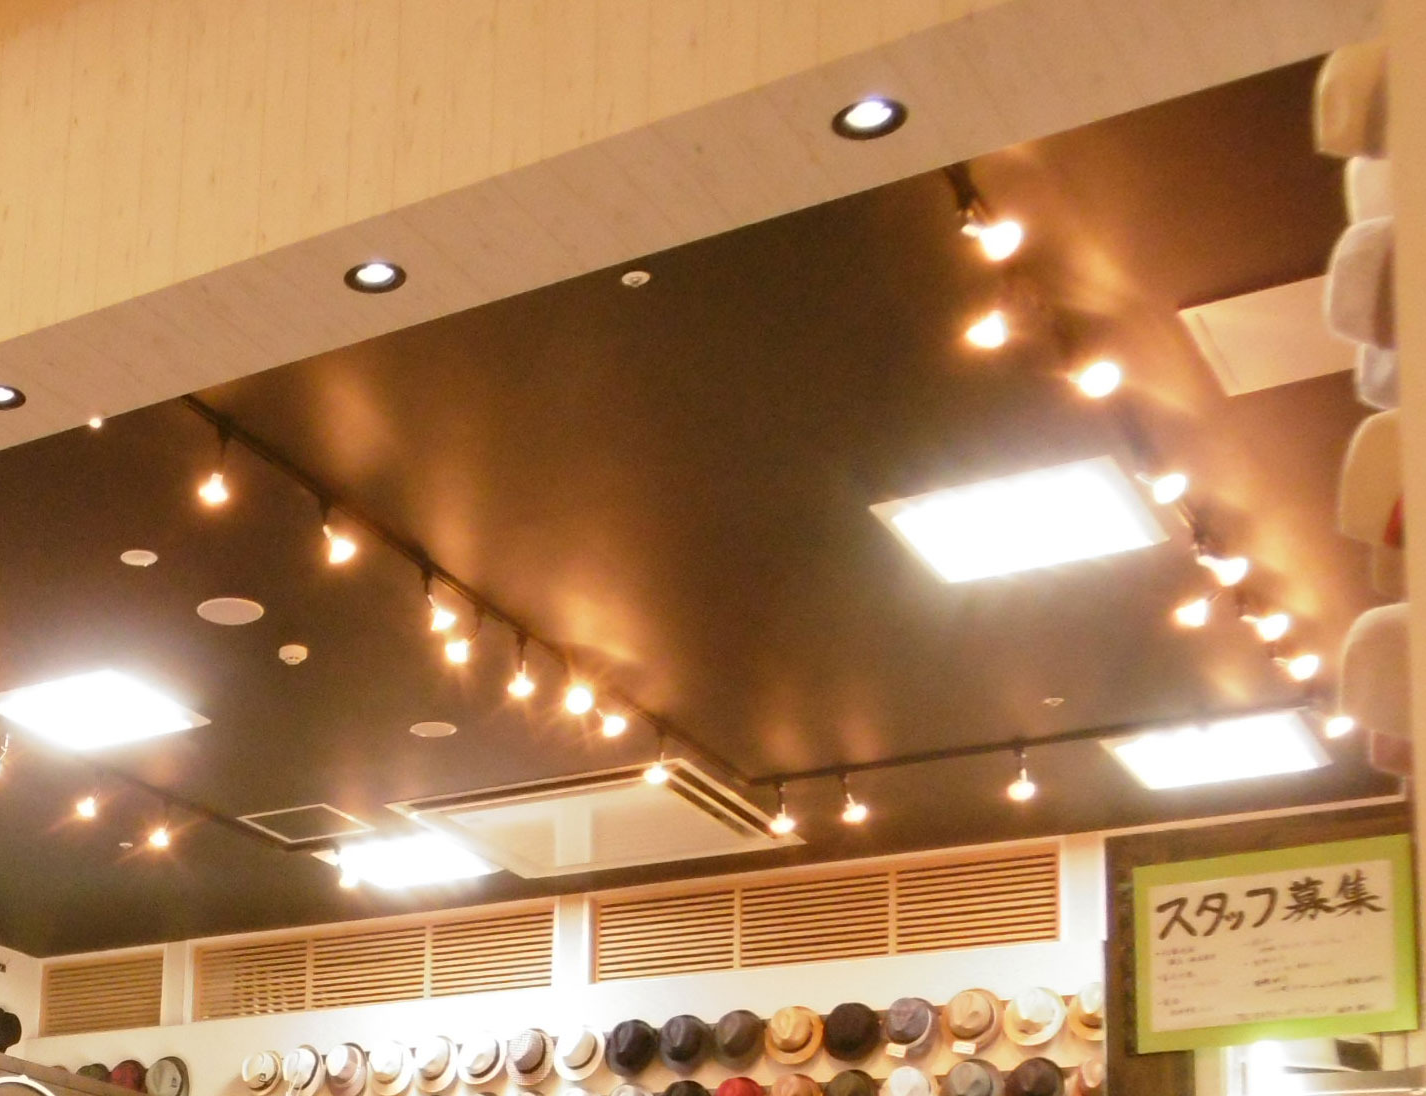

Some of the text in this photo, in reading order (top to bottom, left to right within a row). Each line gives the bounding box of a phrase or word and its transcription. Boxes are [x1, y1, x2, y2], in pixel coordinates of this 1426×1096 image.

[1154, 868, 1387, 940] スタッフ募集
